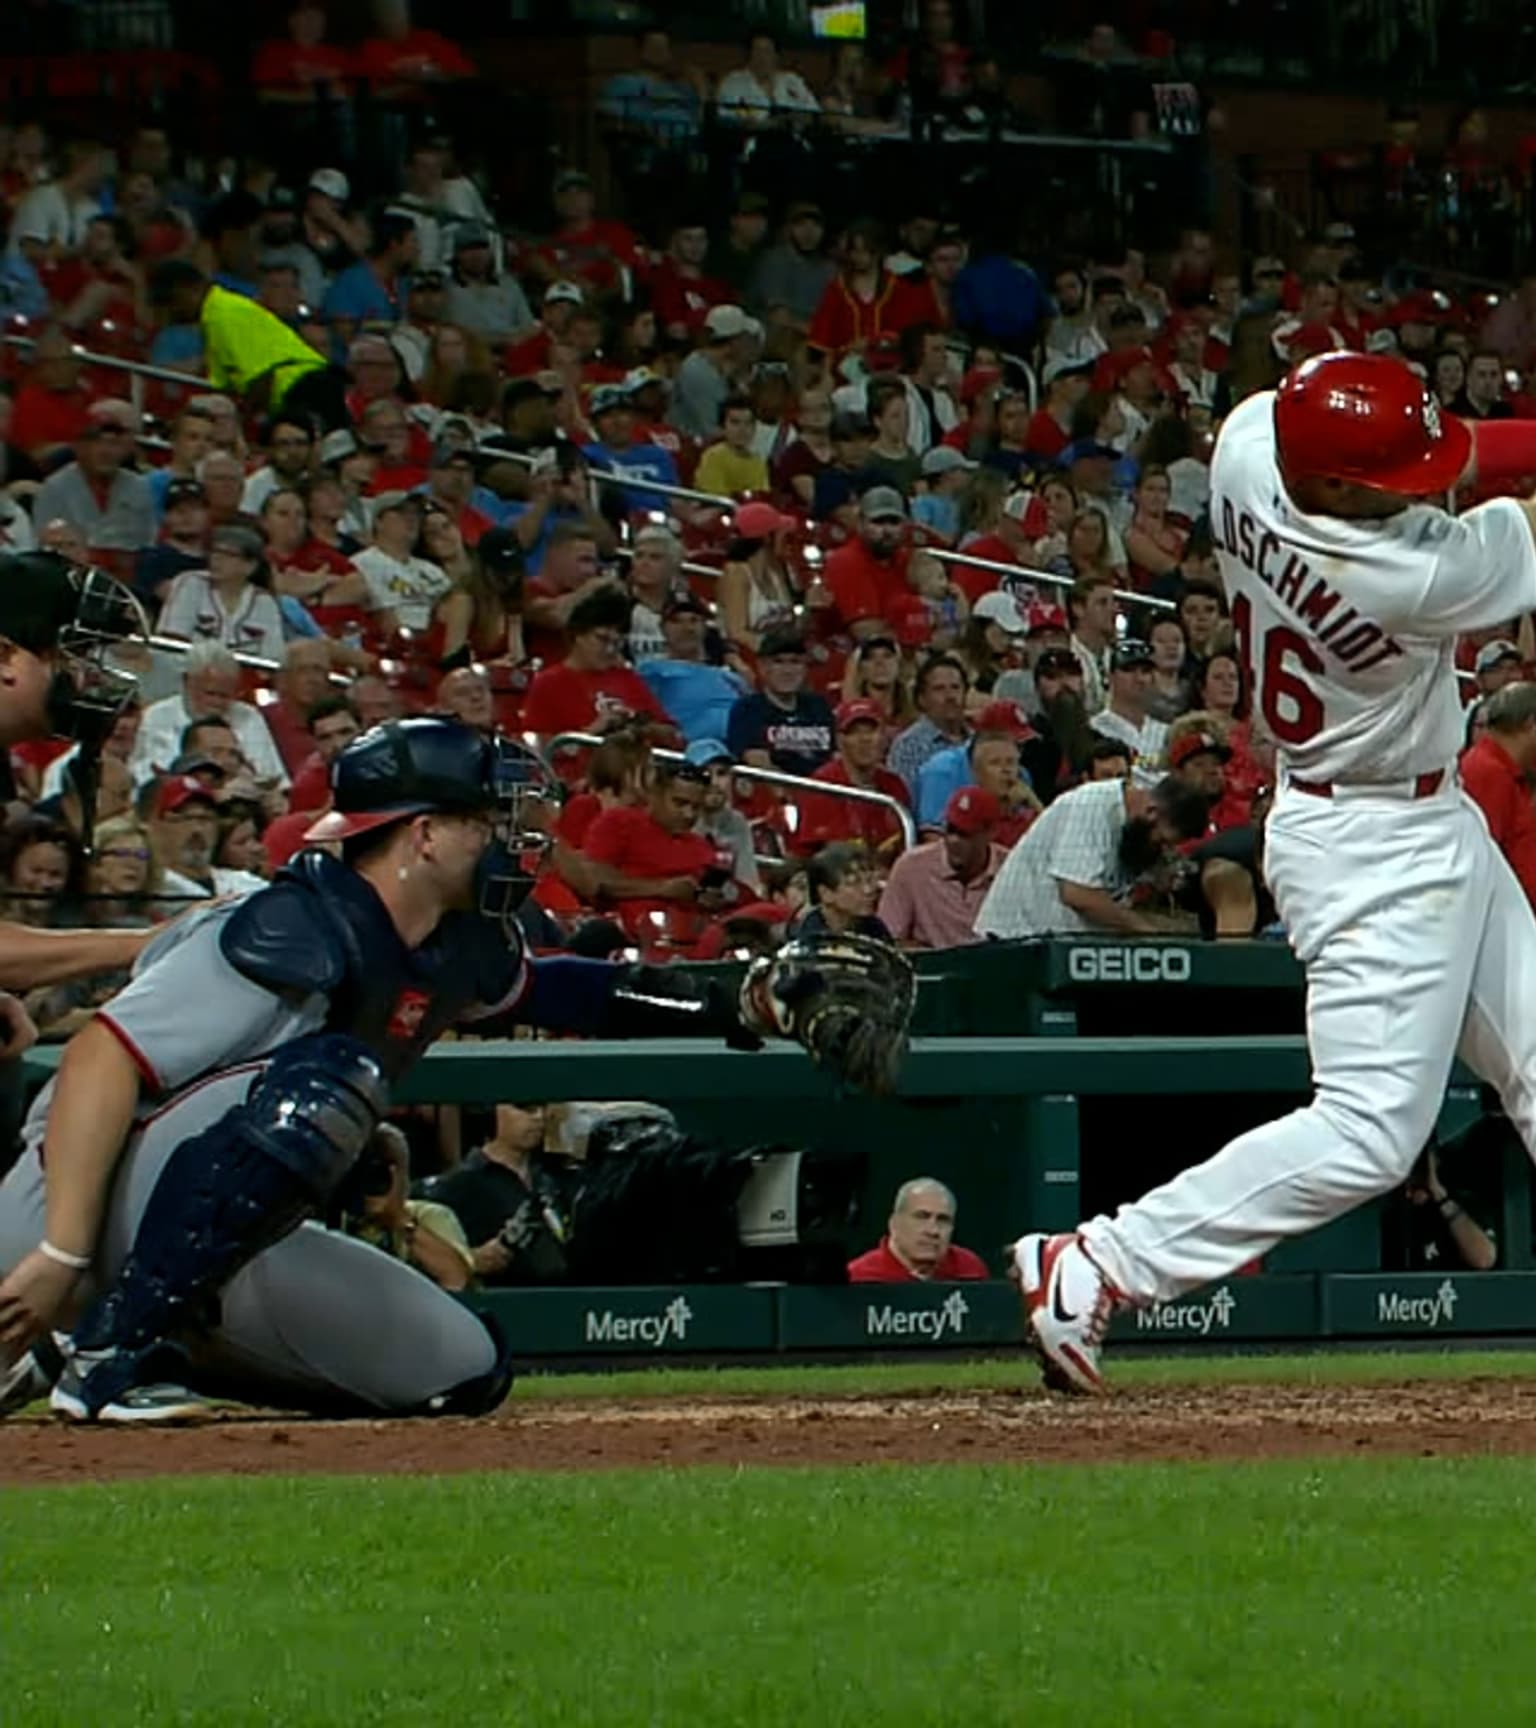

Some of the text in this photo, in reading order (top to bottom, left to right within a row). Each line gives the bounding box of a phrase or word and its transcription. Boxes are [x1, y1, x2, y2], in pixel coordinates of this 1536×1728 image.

[1069, 947, 1191, 981] GEICO
[867, 1305, 946, 1340] Mercy
[1379, 1293, 1440, 1327] Mercy
[586, 1311, 670, 1346] Mercy
